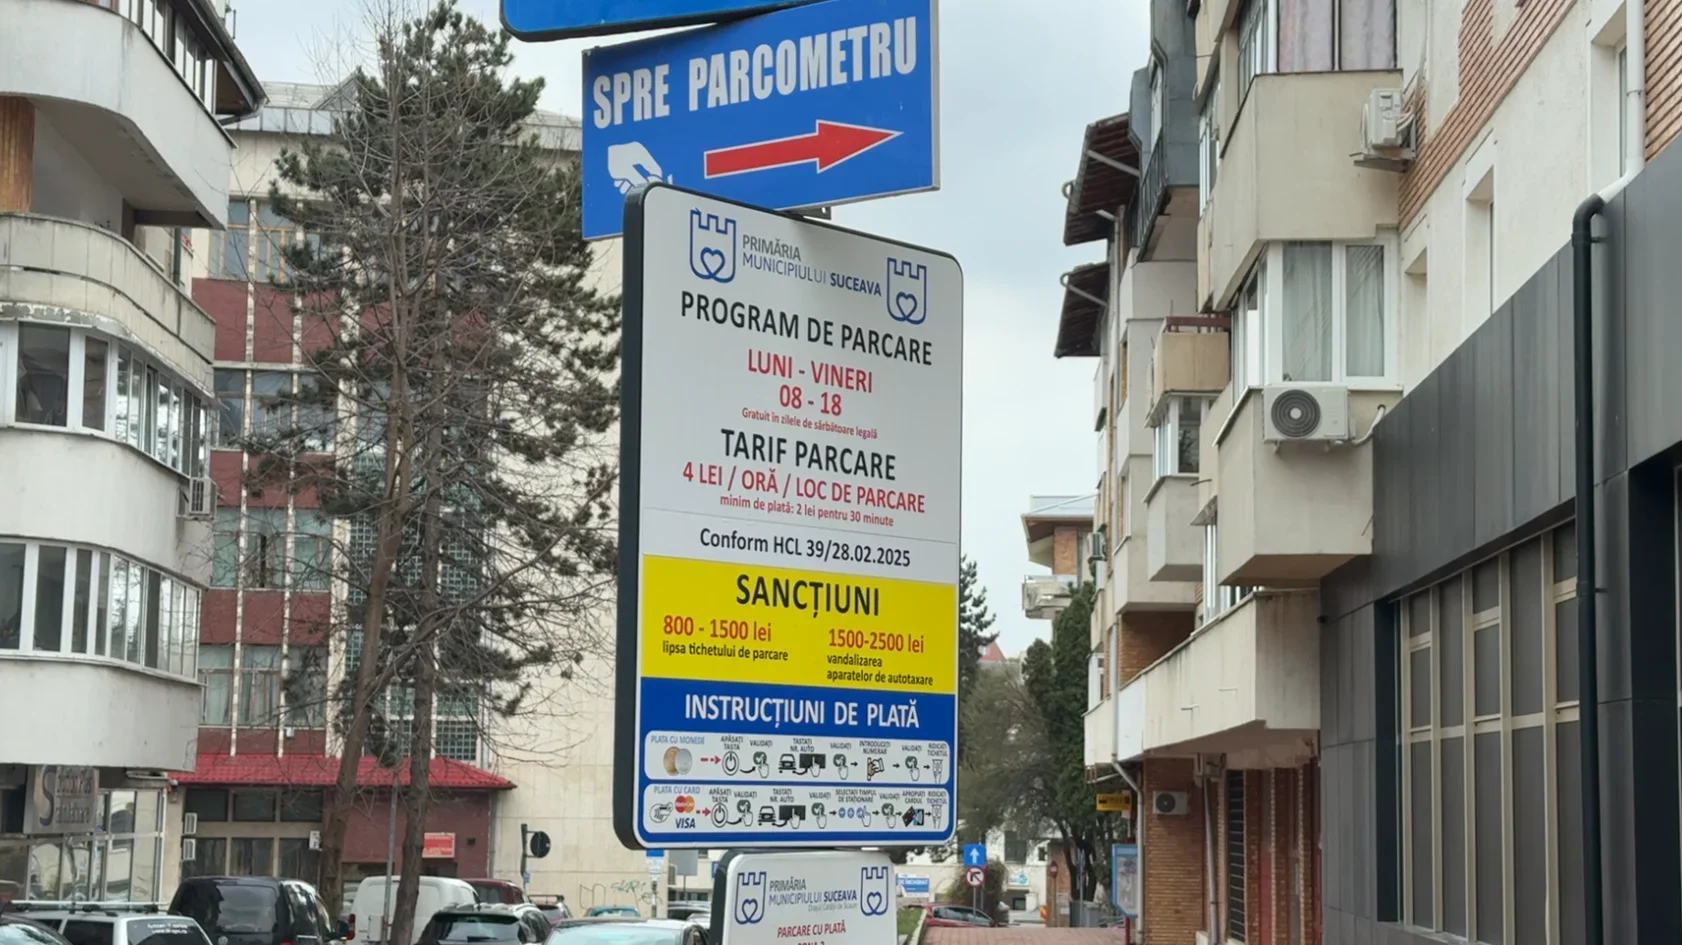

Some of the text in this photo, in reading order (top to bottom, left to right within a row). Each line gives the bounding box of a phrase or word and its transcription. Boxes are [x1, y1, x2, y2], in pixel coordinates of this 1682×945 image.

[593, 16, 917, 129] SPRE PARCOMETRU
[742, 233, 802, 262] PRIMĂRIA
[742, 253, 882, 297] MUNICIPIULUI SUCEAVA
[681, 290, 932, 365] PROGRAM DE PARCARE
[748, 348, 792, 379] LUNI
[811, 360, 873, 393] VINERI
[779, 384, 802, 409] 08
[820, 392, 842, 416] 18
[742, 407, 770, 421] Gratuit
[781, 413, 800, 427] zilele
[802, 418, 813, 429] de
[855, 426, 878, 440] legală
[721, 428, 896, 481] TARIF PARCARE
[683, 461, 925, 513] 4 LEI / ORĂ / LOC DE PARCARE
[720, 494, 894, 527] minim de plată: 2 lei pentru 30 minute
[700, 528, 910, 567] Conform HCL 39/28.02.2025
[736, 574, 879, 618] SANCȚIUNI
[663, 615, 694, 637] 800
[709, 619, 749, 641] 1500
[753, 622, 772, 643] lei
[829, 629, 924, 654] 1500-2500 lei
[663, 640, 788, 663] lipsa tichetului de parcare
[827, 654, 883, 668] vandalizarea
[827, 669, 934, 686] aparatelor de autotaxare
[685, 693, 919, 728] INSTRUCȚIUNI DE PLATĂ
[651, 735, 705, 745] PLATA CU MONEDE
[654, 785, 701, 794] PLATA CU CARD
[675, 818, 696, 829] VISA
[769, 877, 806, 892] PRIMĂRIA
[769, 889, 857, 906] MUNICIPIULUI SUCEAVA
[777, 919, 846, 938] PARCARE CU PLATĂ
